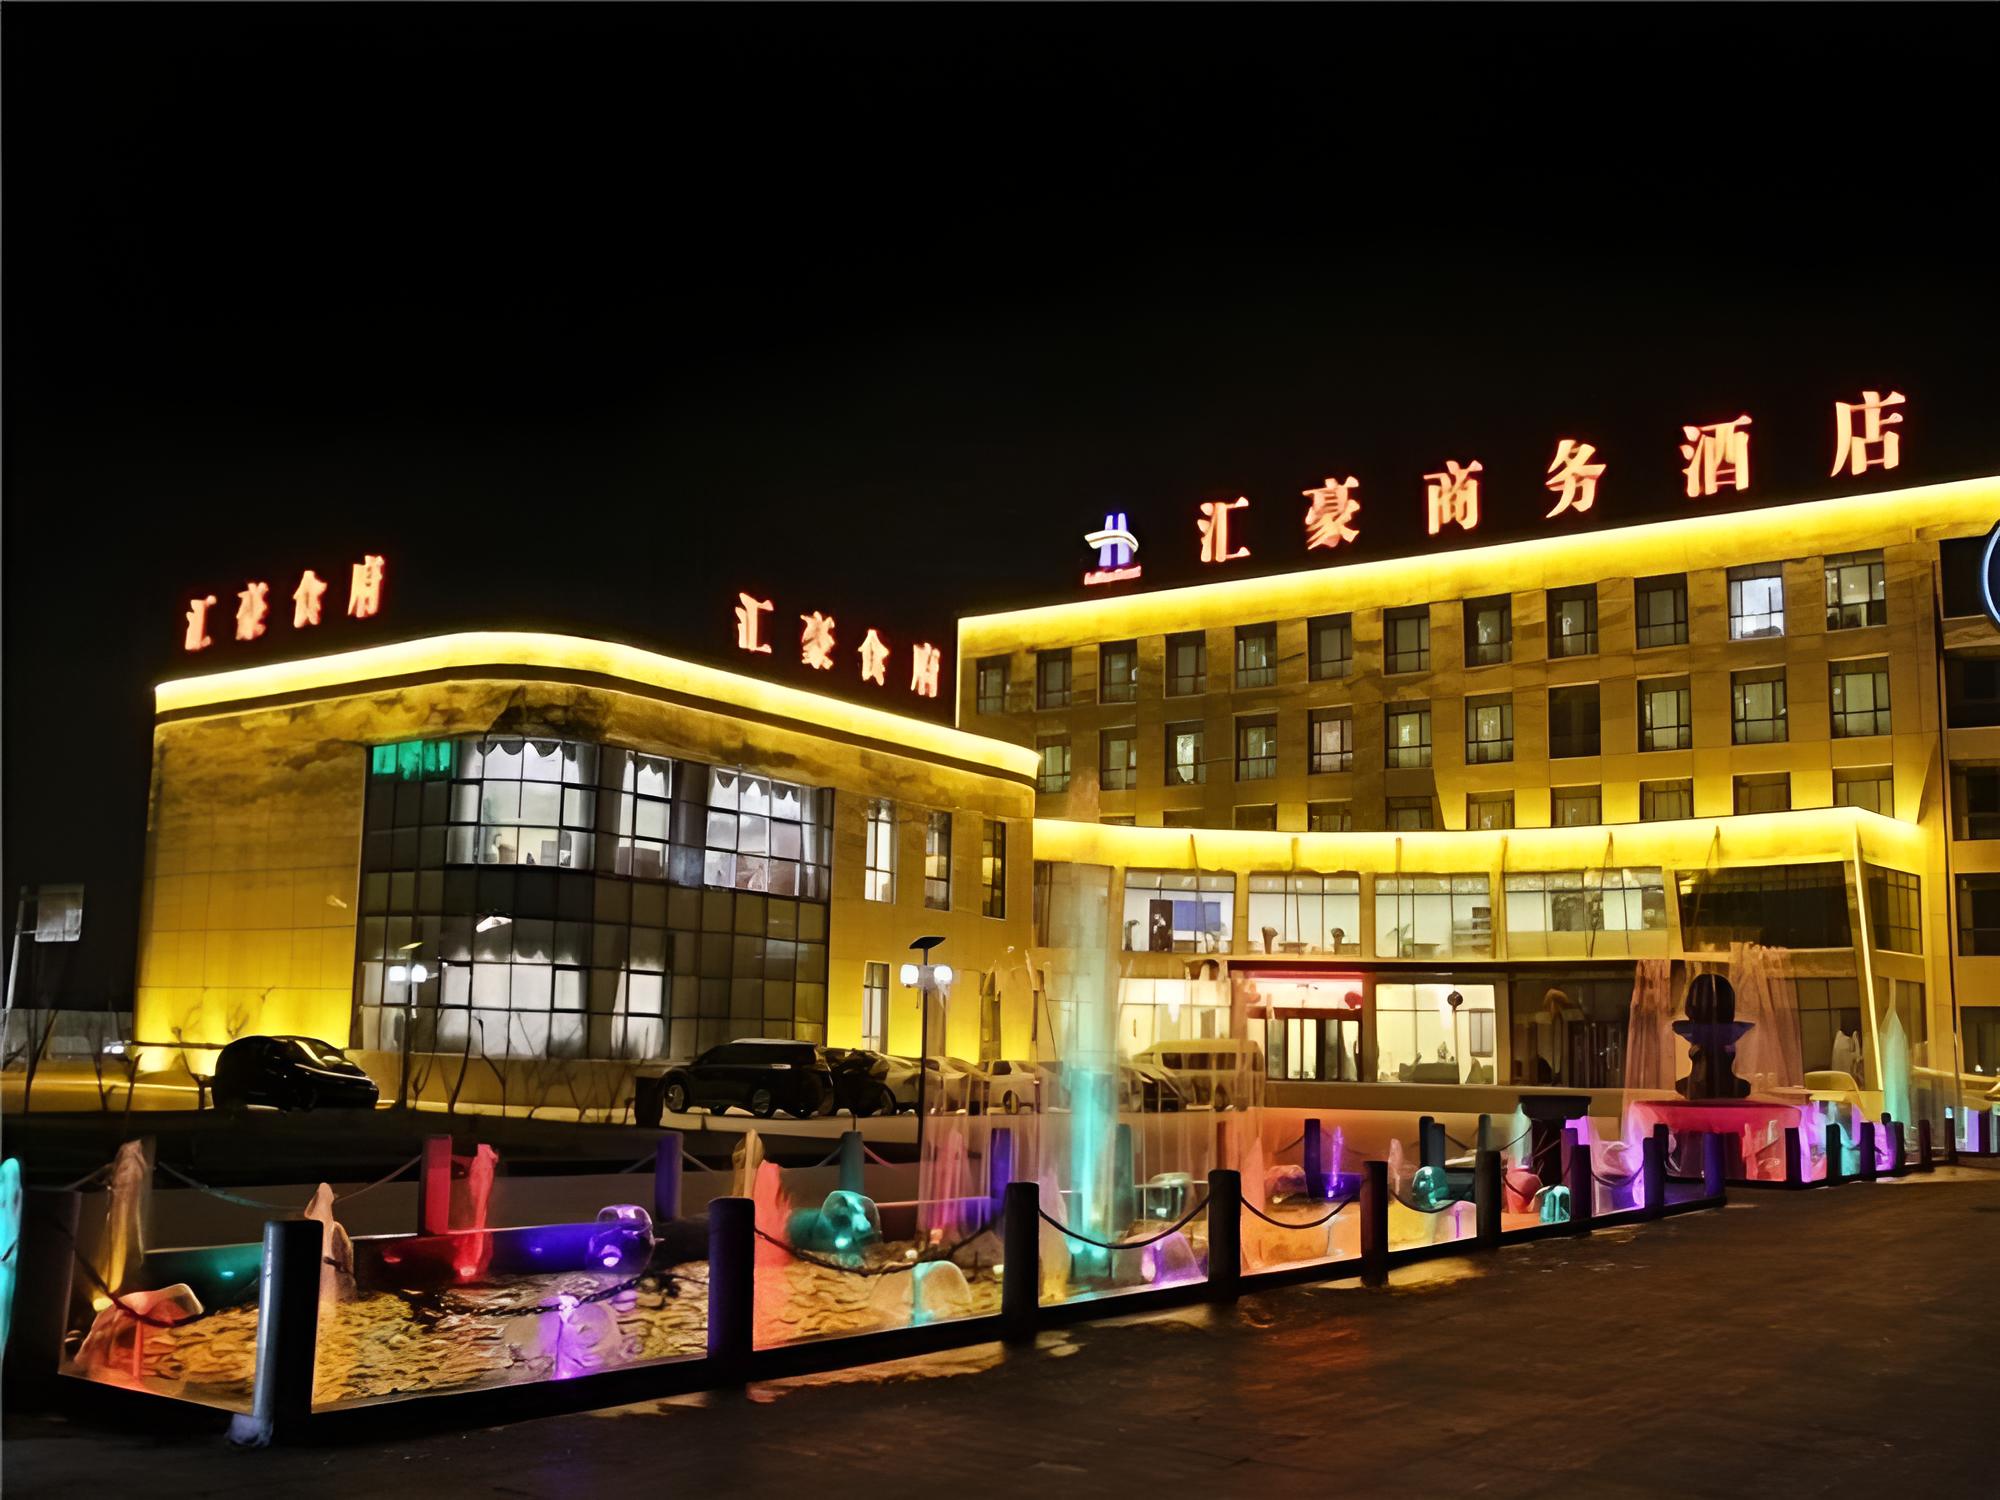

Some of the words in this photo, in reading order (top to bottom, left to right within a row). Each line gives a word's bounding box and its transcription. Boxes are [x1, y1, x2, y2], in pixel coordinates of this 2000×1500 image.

[1197, 391, 1906, 563] 汇豪商务酒店
